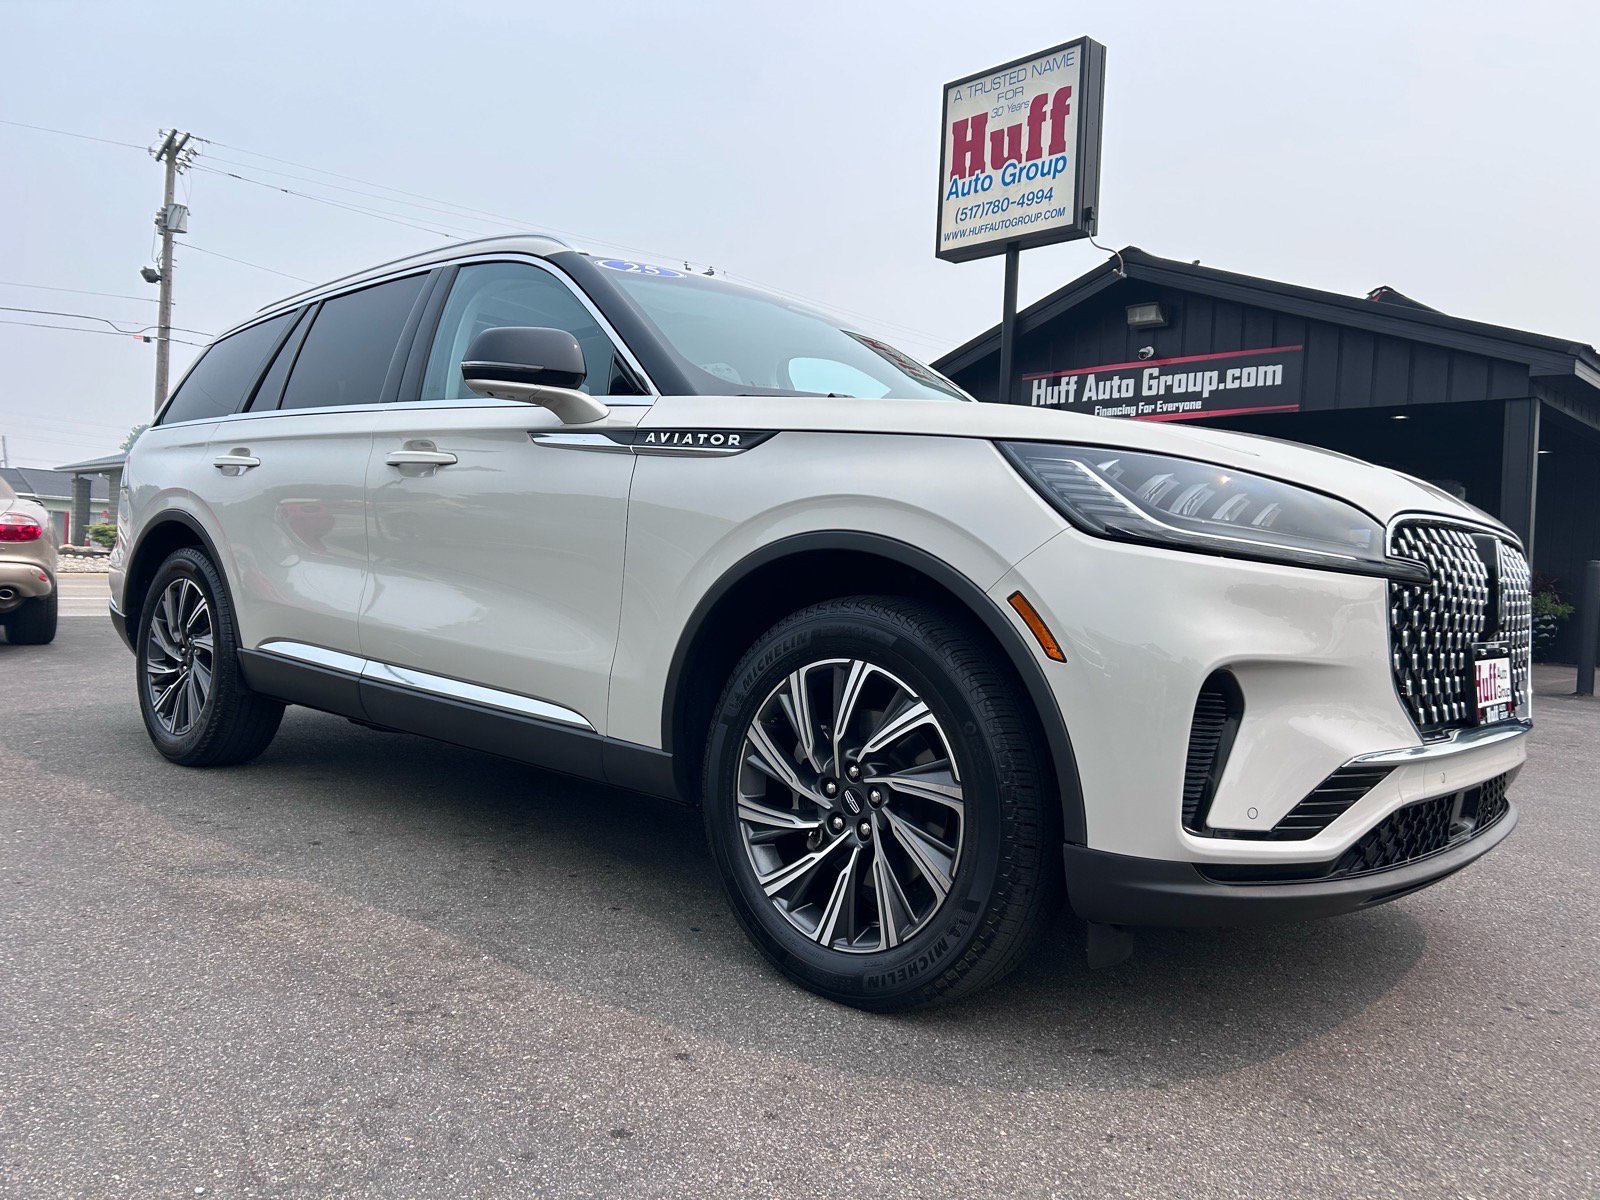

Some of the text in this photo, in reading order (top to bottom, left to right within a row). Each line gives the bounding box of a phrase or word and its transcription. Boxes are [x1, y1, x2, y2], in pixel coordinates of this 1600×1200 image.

[953, 52, 1076, 104] A TRUSTED NAME
[997, 86, 1024, 103] FOR
[990, 100, 1030, 119] 30 Years
[950, 86, 1072, 182] Huff
[946, 155, 1067, 201] Auto Group
[943, 207, 1066, 242] WWW.HUFFAUTOGROUP.COM
[954, 187, 1054, 225] (517)780-4994
[624, 261, 660, 275] 25
[1031, 364, 1283, 406] Huff Auto Group.com
[1094, 400, 1202, 417] Financing For Everyone
[645, 432, 741, 446] AVIATOR
[742, 631, 808, 690] MICHELIN
[1475, 662, 1498, 704] Huff
[867, 937, 949, 988] MICHELIN
